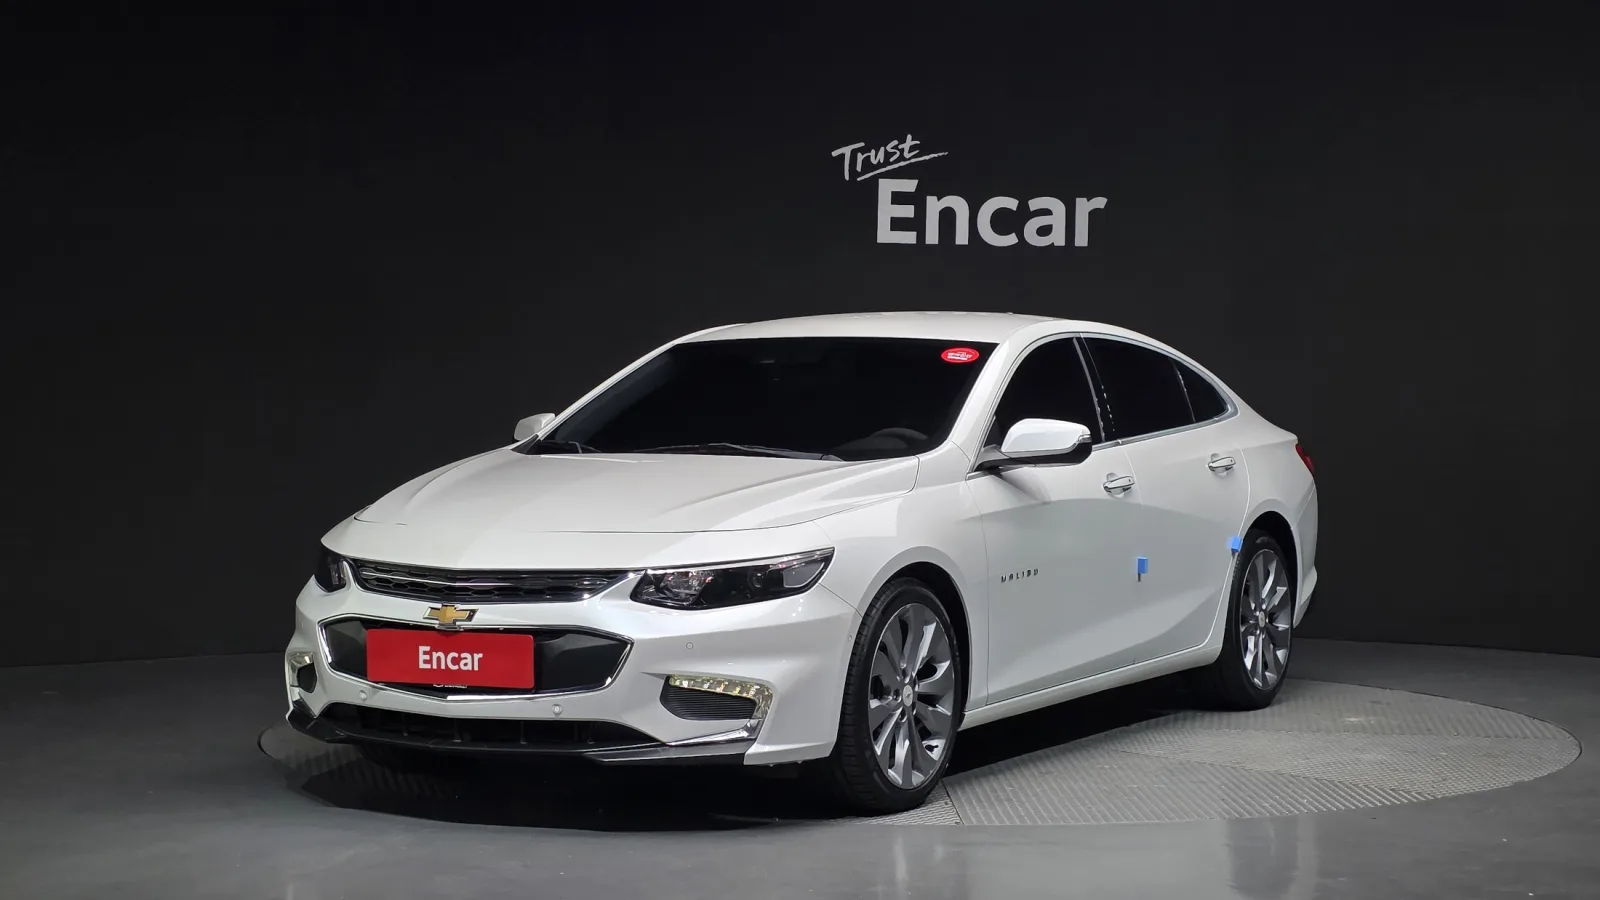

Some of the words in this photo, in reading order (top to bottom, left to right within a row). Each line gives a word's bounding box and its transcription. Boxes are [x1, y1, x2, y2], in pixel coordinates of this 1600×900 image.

[831, 134, 921, 181] Trust
[877, 178, 1108, 247] Encar
[1000, 568, 1039, 584] MALIBU
[418, 645, 484, 671] Encar
